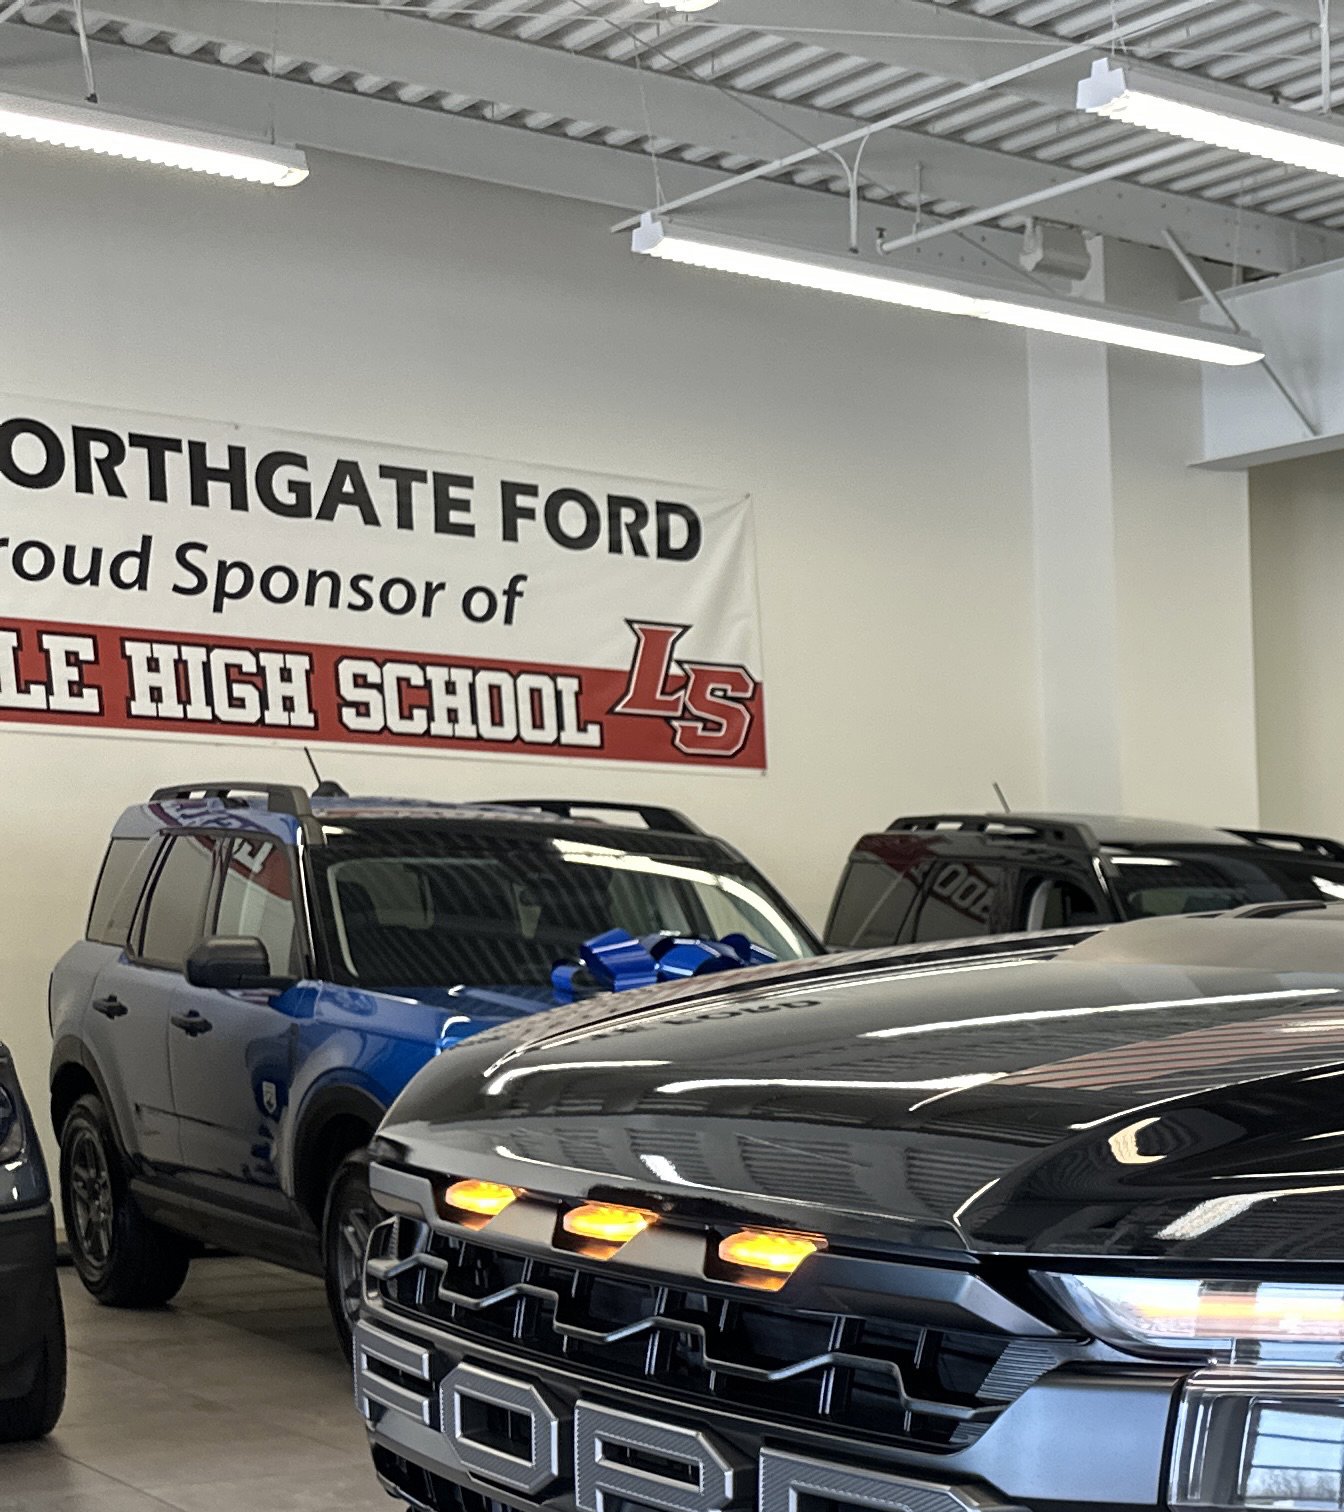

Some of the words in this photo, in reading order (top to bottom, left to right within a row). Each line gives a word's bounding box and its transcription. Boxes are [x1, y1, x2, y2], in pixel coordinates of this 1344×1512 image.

[0, 417, 476, 538] ORTHGATE
[500, 480, 701, 562] FORD
[171, 541, 446, 618] Sponsor
[461, 573, 528, 626] of
[121, 637, 318, 730] HIGH
[337, 656, 604, 750] SCHOOL
